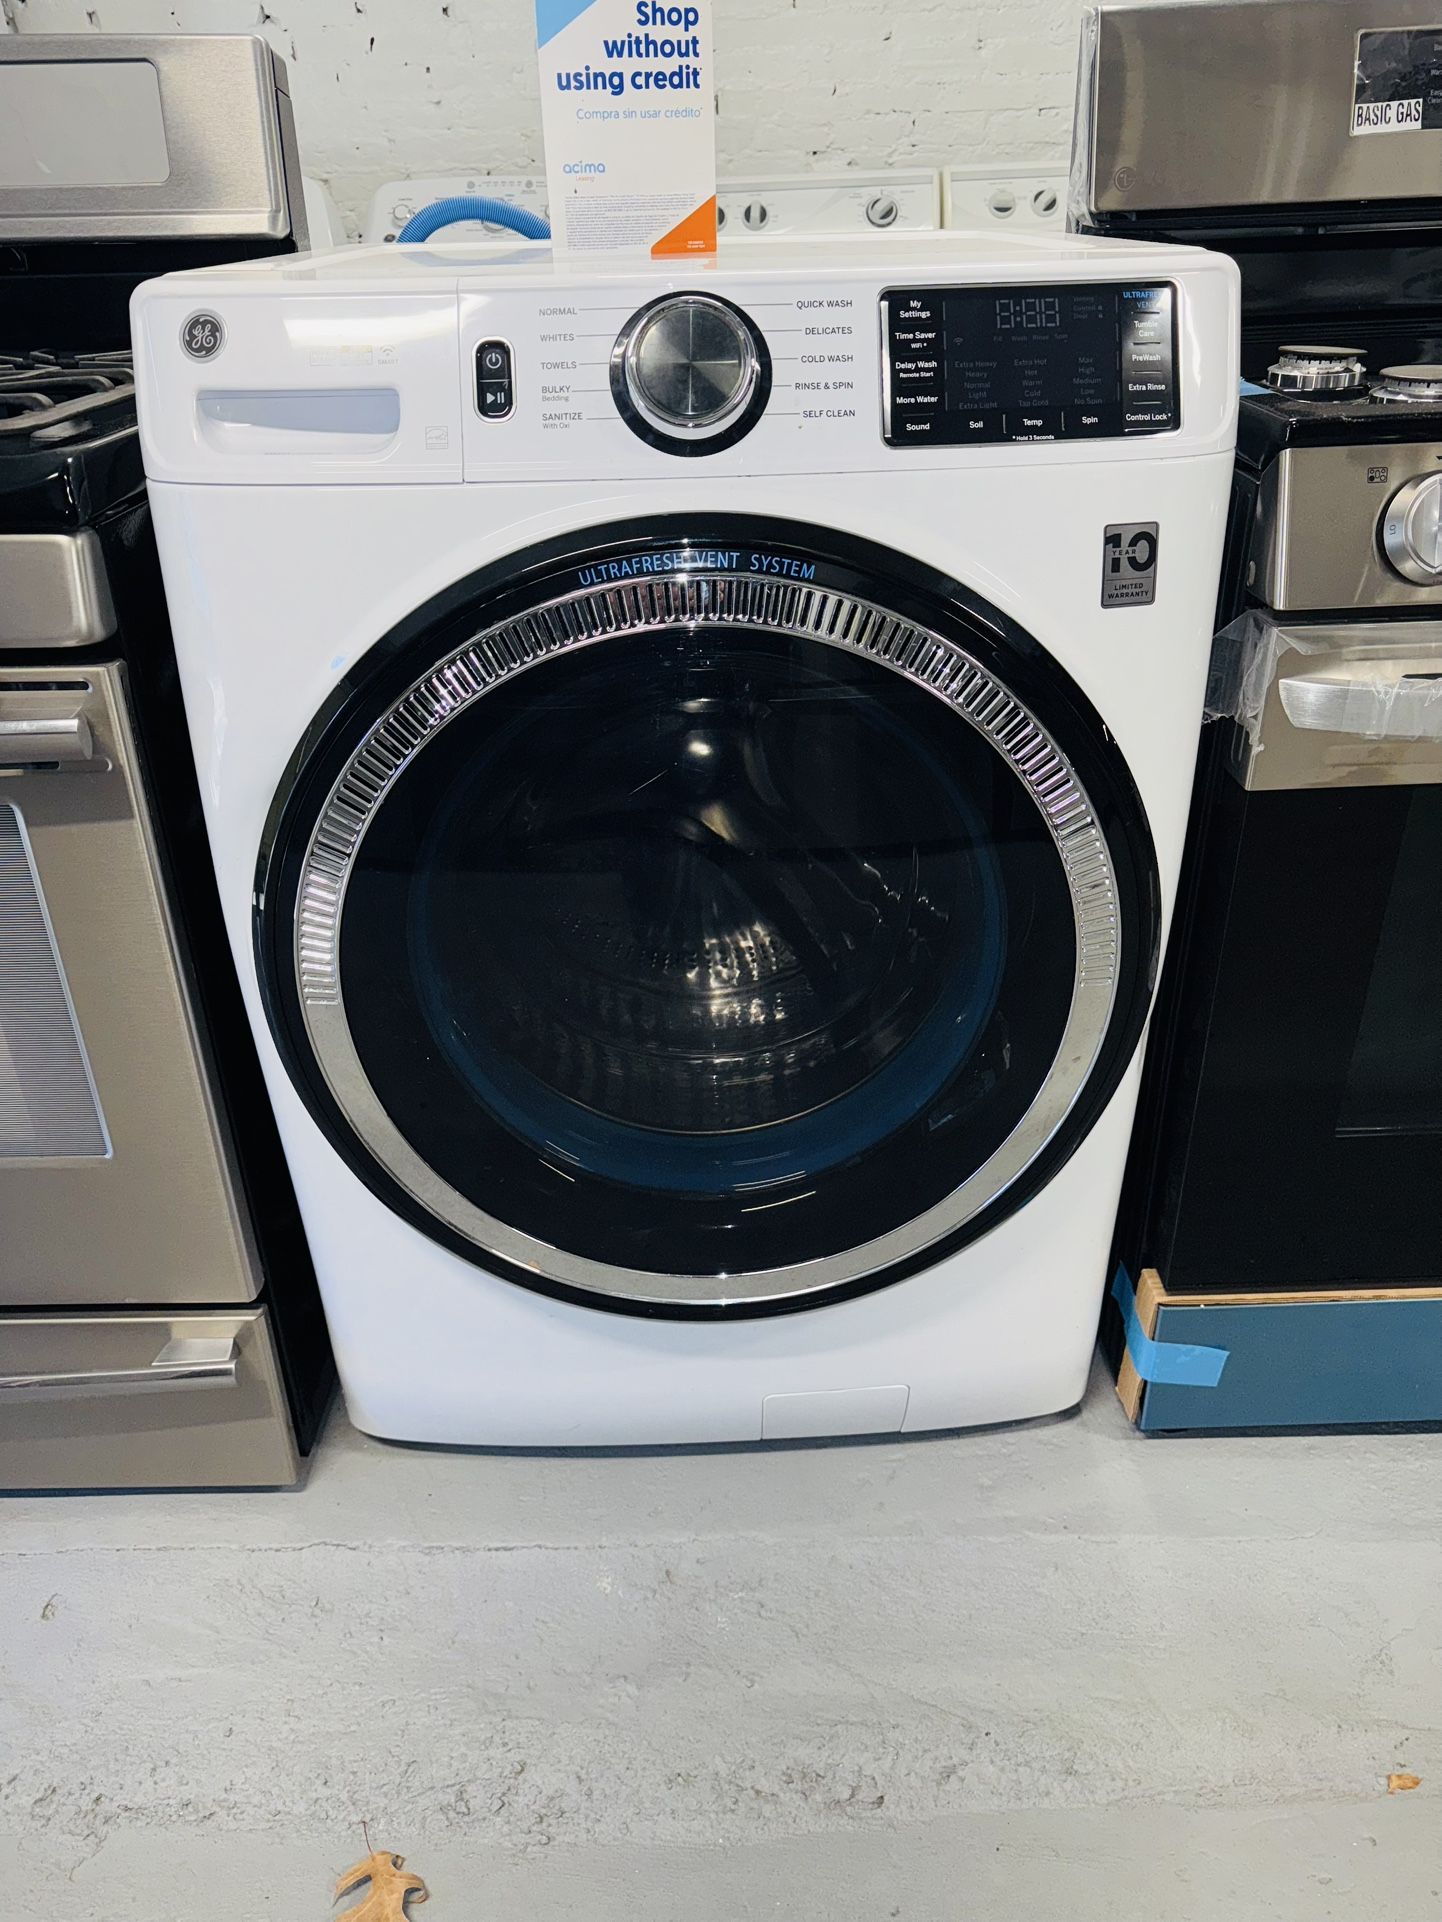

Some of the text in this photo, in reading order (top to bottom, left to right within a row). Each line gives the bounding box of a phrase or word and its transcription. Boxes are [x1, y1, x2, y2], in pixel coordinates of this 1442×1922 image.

[636, 1, 699, 32] Shop
[603, 33, 700, 58] without
[557, 65, 624, 96] using
[576, 108, 620, 122] Compra
[623, 107, 637, 119] sin
[640, 109, 662, 119] usar
[1357, 100, 1421, 127] BASIC GAS
[563, 160, 606, 174] acima
[796, 300, 853, 310] QUICK WASH
[910, 300, 922, 309] My
[539, 307, 577, 316] NORMAL
[900, 310, 931, 319] Settings
[1134, 320, 1158, 328] Tumble
[805, 327, 853, 335] DELICATES
[895, 331, 936, 340] Time Saver
[1138, 329, 1154, 337] Care
[540, 333, 575, 342] WHITES
[800, 354, 854, 363] COLD WASH
[1132, 354, 1161, 362] PreWash
[540, 361, 577, 370] TOWELS
[895, 361, 916, 370] Delay
[541, 385, 571, 394] BULKY
[795, 381, 854, 390] RINSE & SPIN
[1128, 383, 1166, 391] Extra Rinse
[896, 395, 939, 404] More Water
[542, 412, 583, 421] SANITIZE
[802, 409, 856, 418] SELF CLEAN
[1126, 413, 1151, 421] Control
[1023, 419, 1043, 427] Temp
[1082, 416, 1099, 424] Spin
[906, 423, 930, 431] Sound
[969, 421, 984, 429] Soil
[1105, 531, 1157, 573] 10
[578, 551, 817, 586] ULTRAFRESH VENT SYSTEM
[1114, 582, 1144, 591] LIMITED
[1107, 590, 1149, 600] WARRANTY
